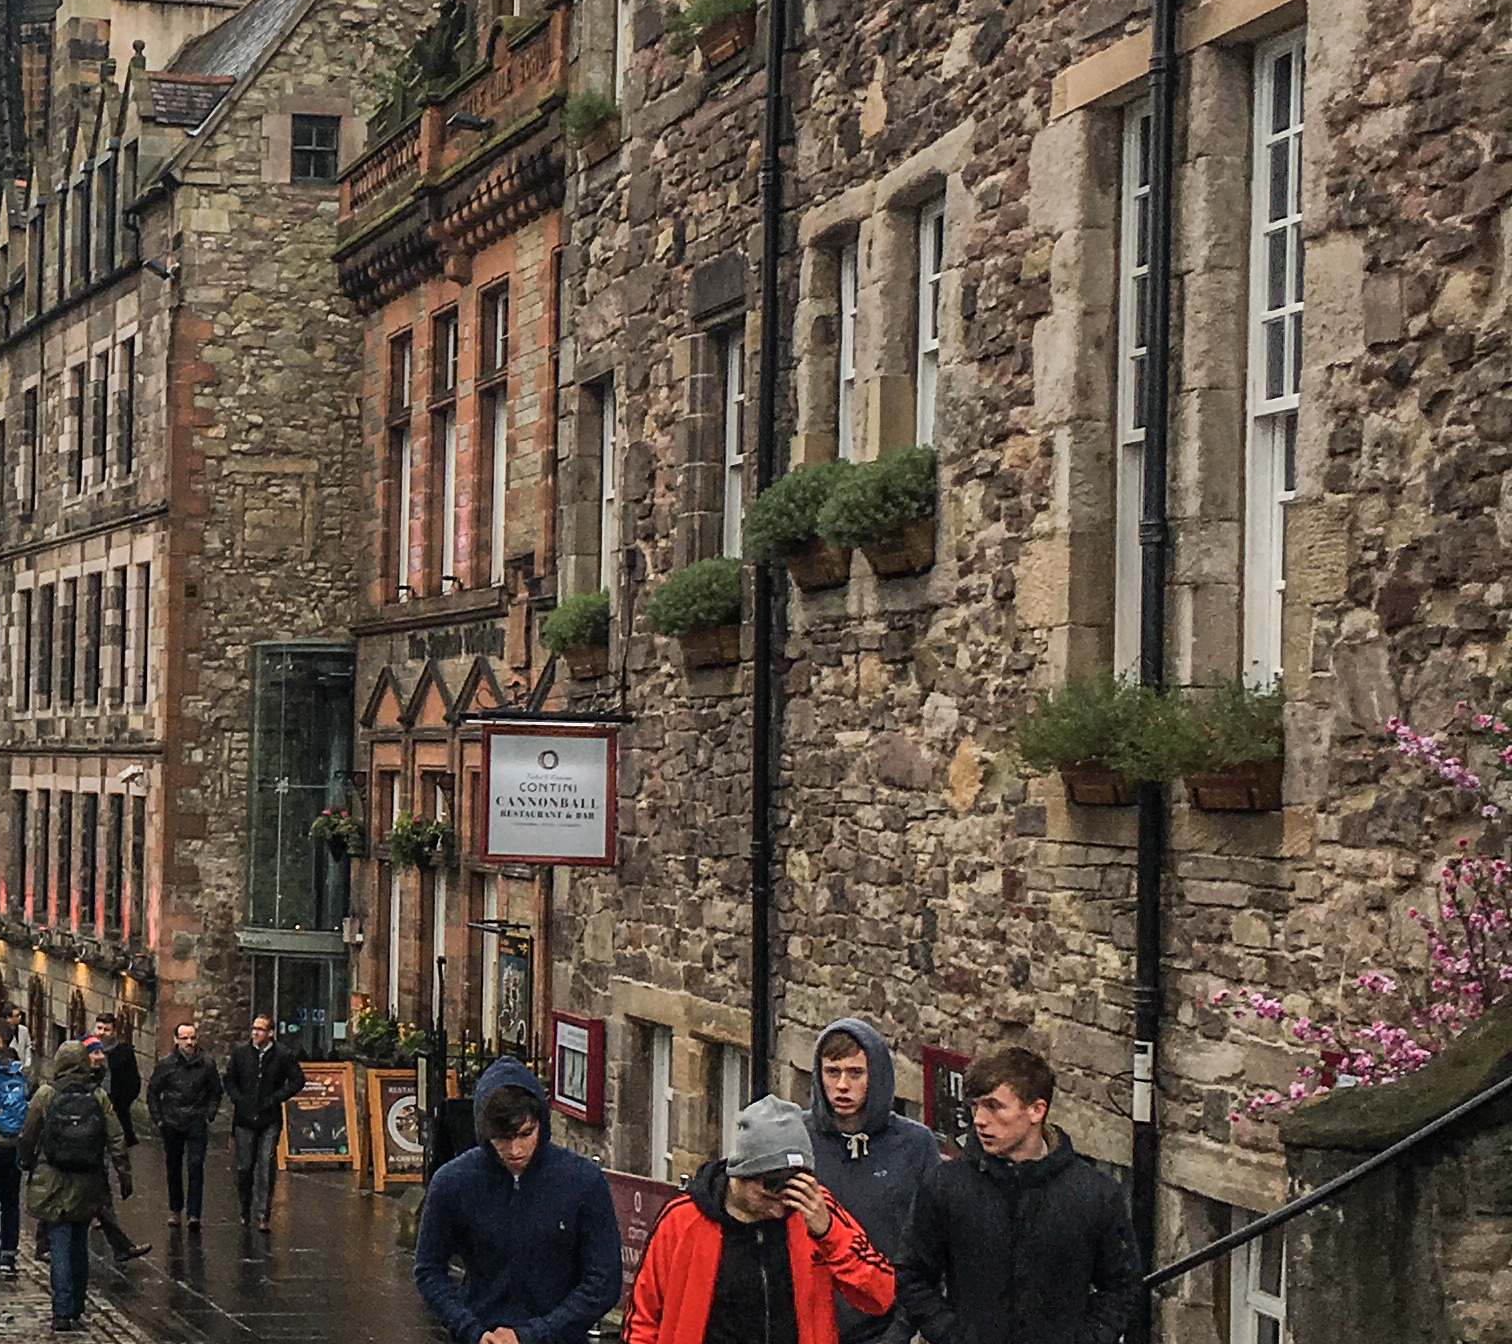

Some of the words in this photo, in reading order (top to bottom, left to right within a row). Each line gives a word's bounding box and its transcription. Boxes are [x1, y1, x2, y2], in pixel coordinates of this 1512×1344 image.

[519, 782, 577, 793] CONTINI
[495, 796, 599, 809] CANNONBALL
[500, 810, 562, 819] RESTAURANT
[565, 811, 572, 819] &
[576, 812, 595, 820] BAR
